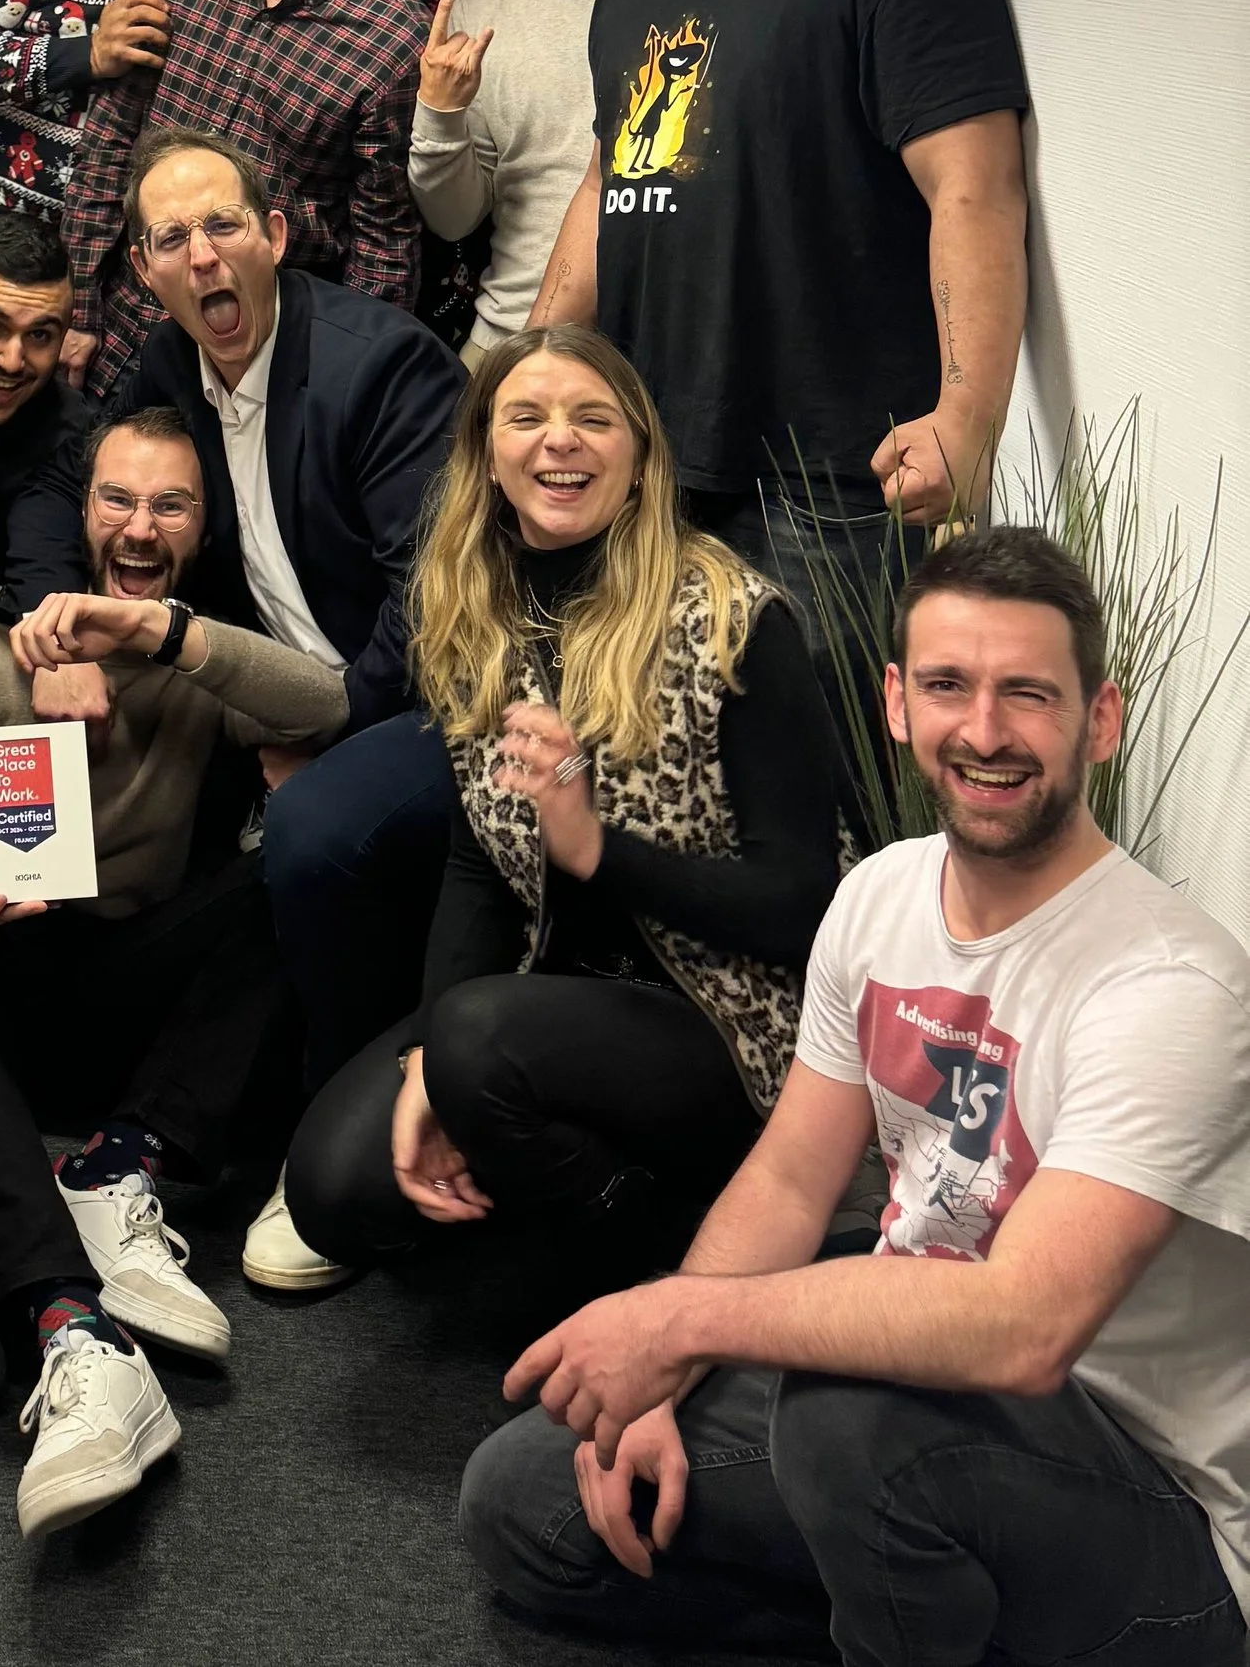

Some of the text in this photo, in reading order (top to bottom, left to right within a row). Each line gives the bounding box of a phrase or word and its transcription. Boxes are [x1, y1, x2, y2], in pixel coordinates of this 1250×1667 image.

[605, 186, 678, 214] DO IT.
[14, 836, 37, 844] FRANCE
[895, 999, 978, 1047] Advertising
